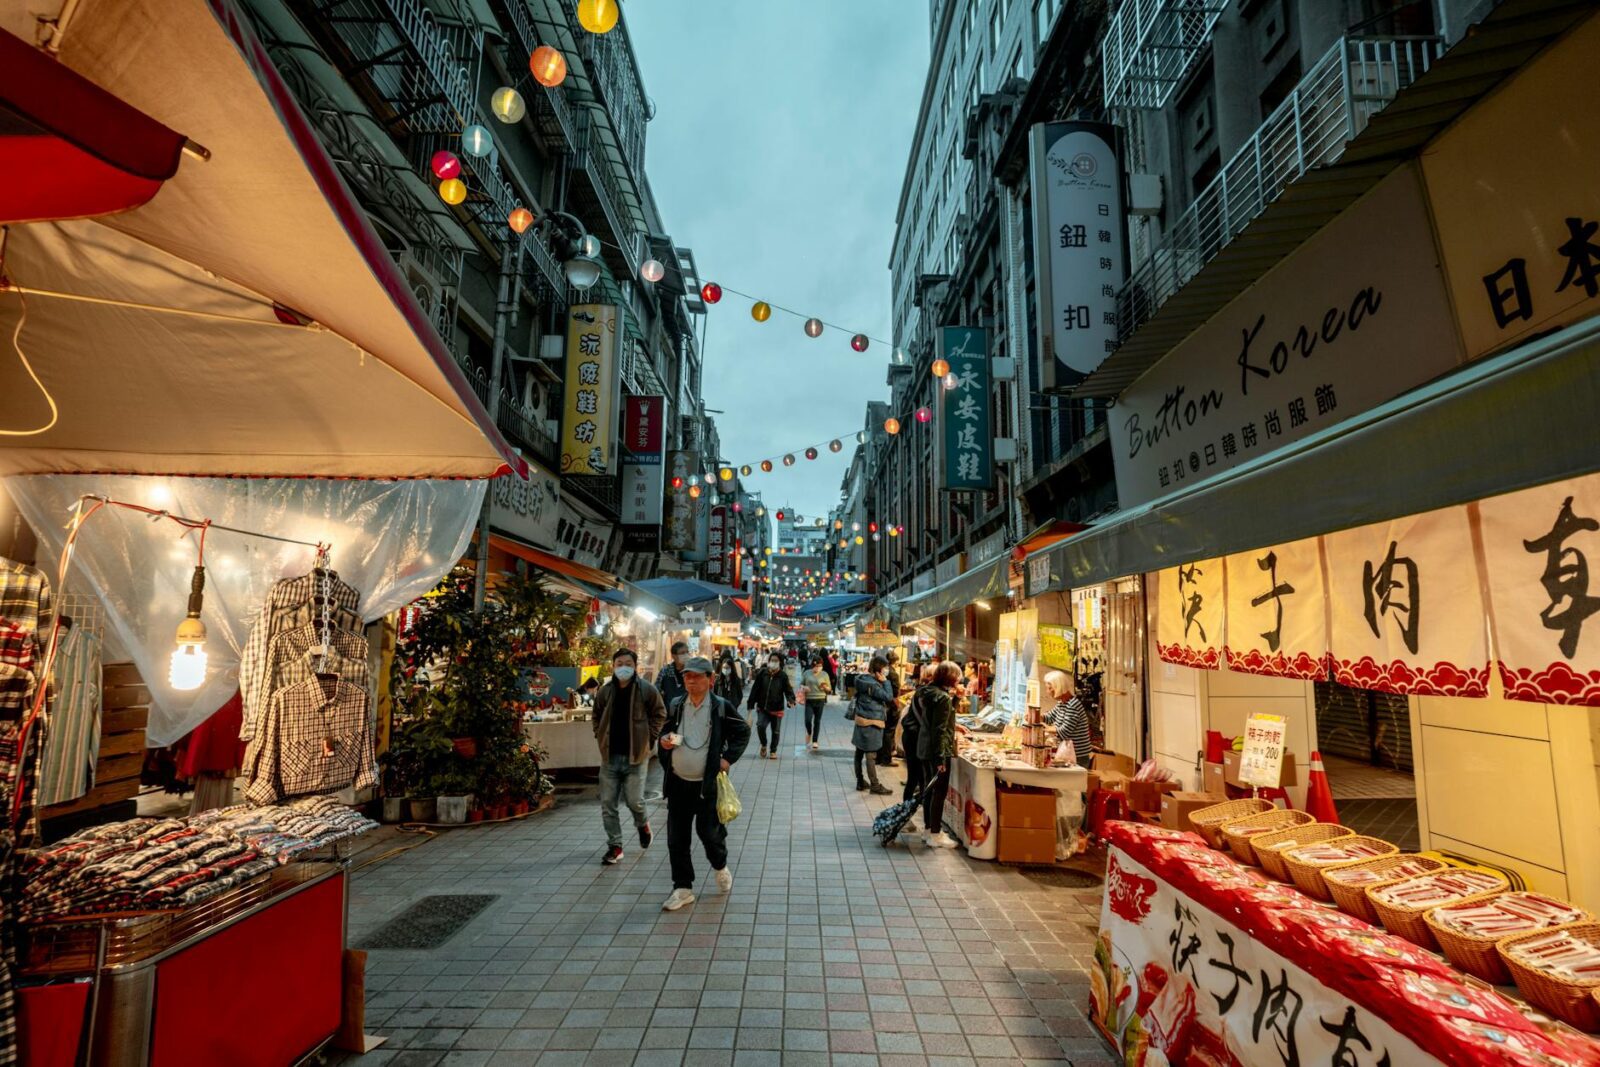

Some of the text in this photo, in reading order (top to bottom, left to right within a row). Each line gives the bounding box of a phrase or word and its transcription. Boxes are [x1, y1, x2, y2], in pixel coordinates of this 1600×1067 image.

[1059, 223, 1090, 331] 鈕扣
[574, 333, 601, 443] 沅陵鞋坊
[953, 363, 983, 481] 永安皮鞋
[1124, 285, 1382, 461] Button Korea
